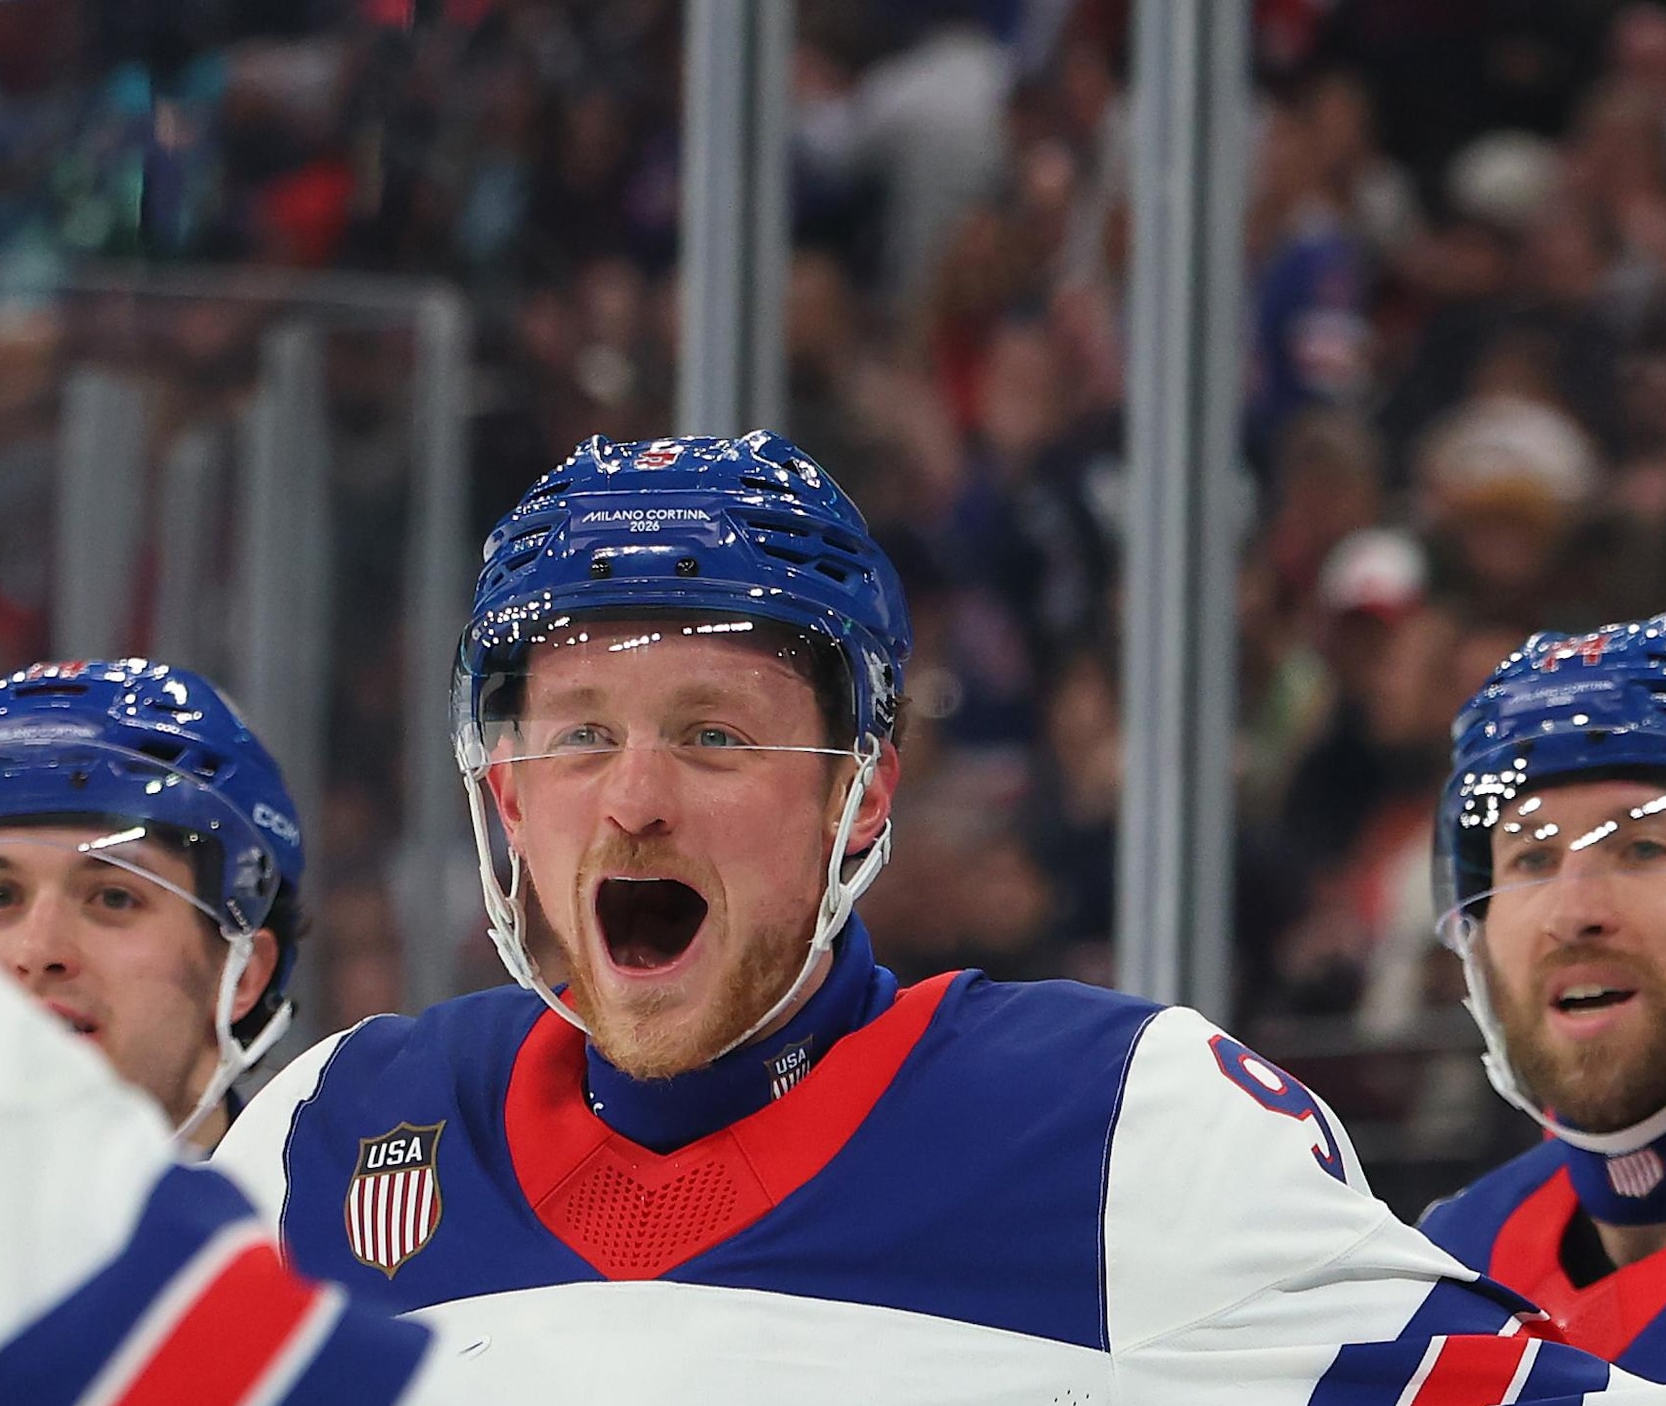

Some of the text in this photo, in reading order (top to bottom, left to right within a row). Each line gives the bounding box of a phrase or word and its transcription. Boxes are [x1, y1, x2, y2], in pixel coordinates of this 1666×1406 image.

[582, 509, 710, 523] MILANO CORTINA
[630, 521, 660, 532] 2026
[774, 1047, 808, 1076] USA
[1207, 1034, 1348, 1185] 9
[367, 1136, 423, 1169] USA
